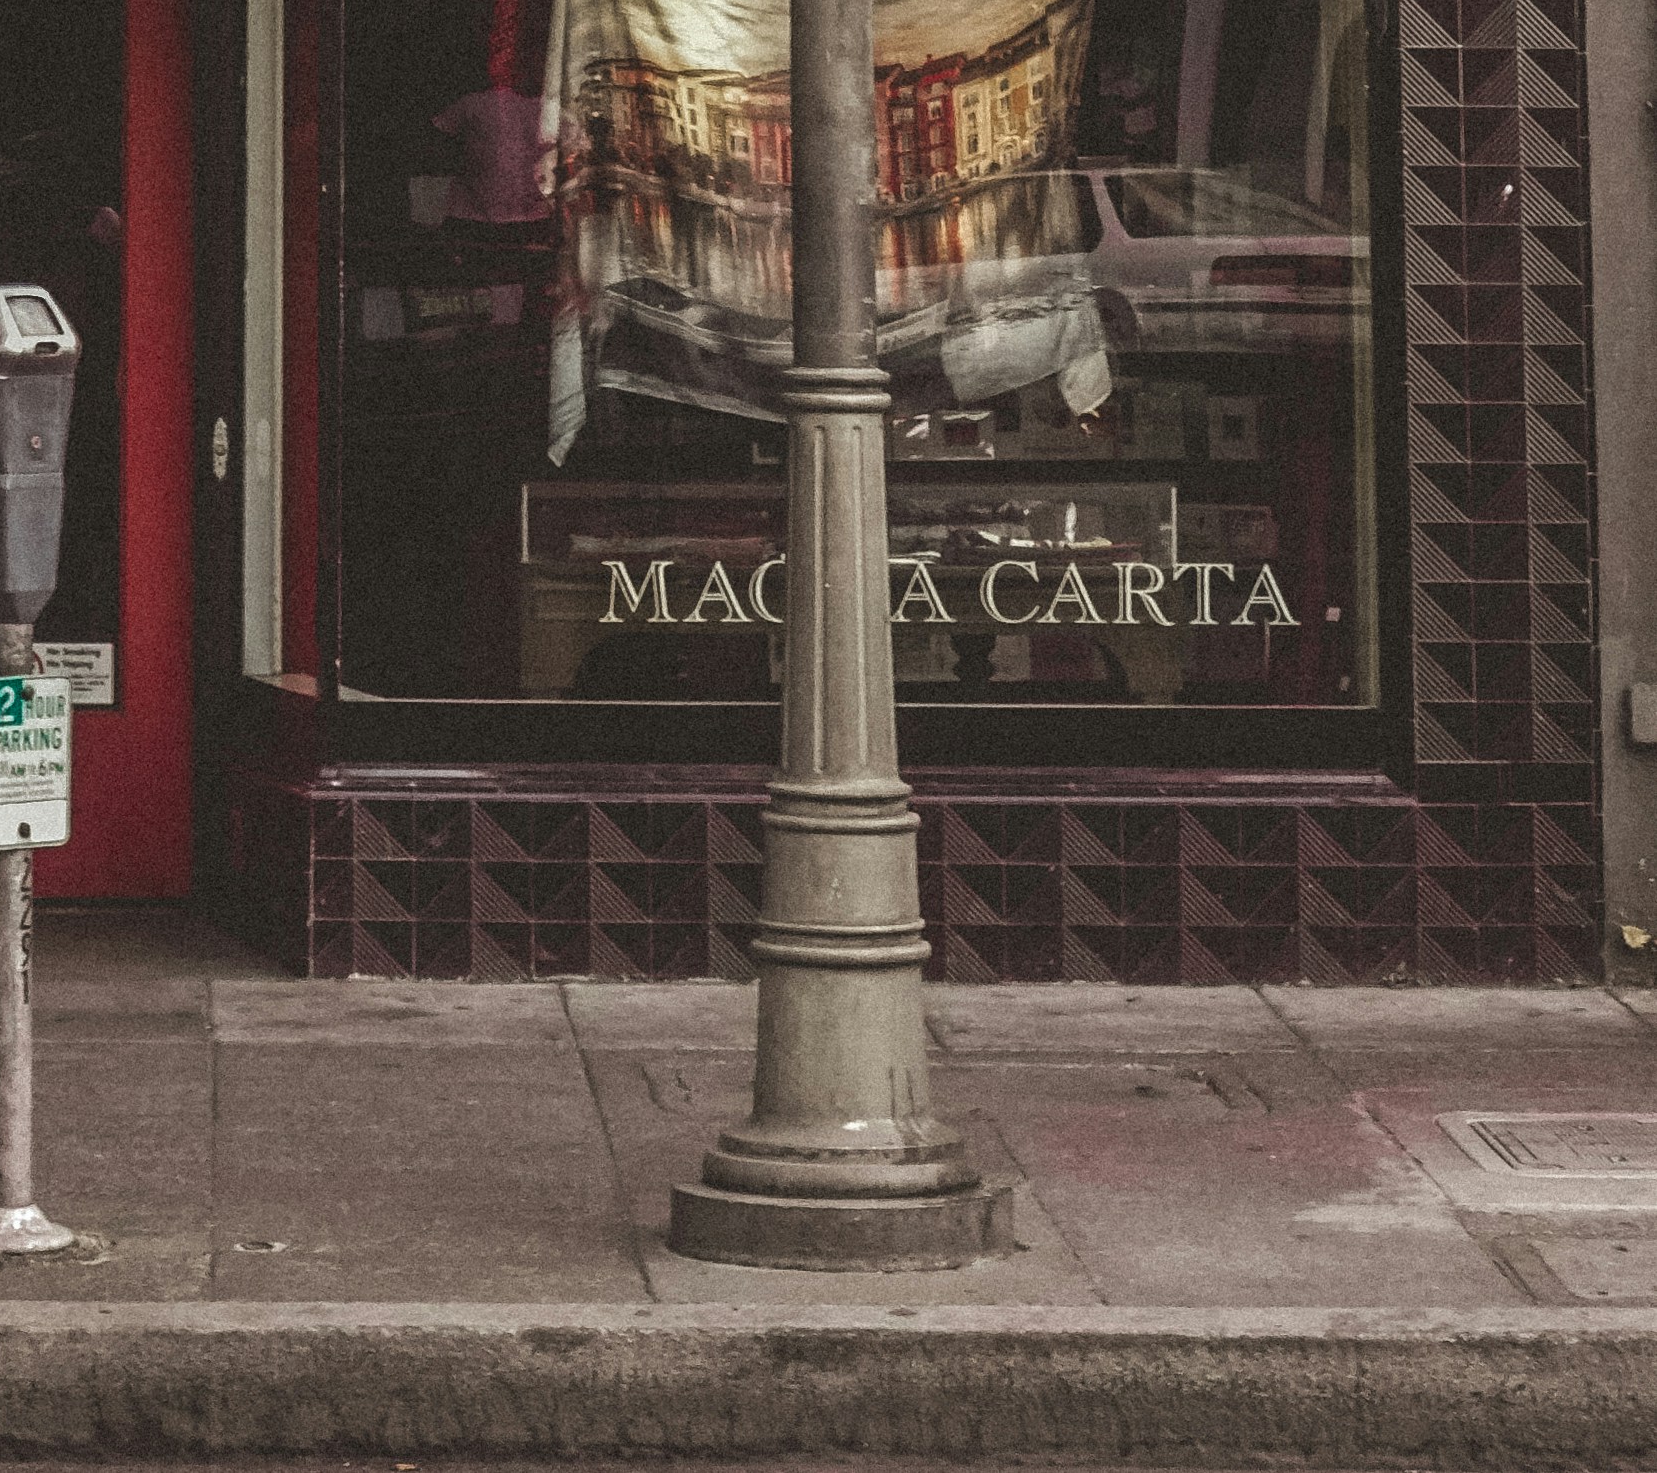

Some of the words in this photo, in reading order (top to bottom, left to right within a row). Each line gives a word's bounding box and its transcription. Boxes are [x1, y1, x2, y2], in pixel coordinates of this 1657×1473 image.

[598, 559, 958, 623] MAGA
[979, 560, 1302, 627] CARTA
[24, 694, 65, 720] HOUR
